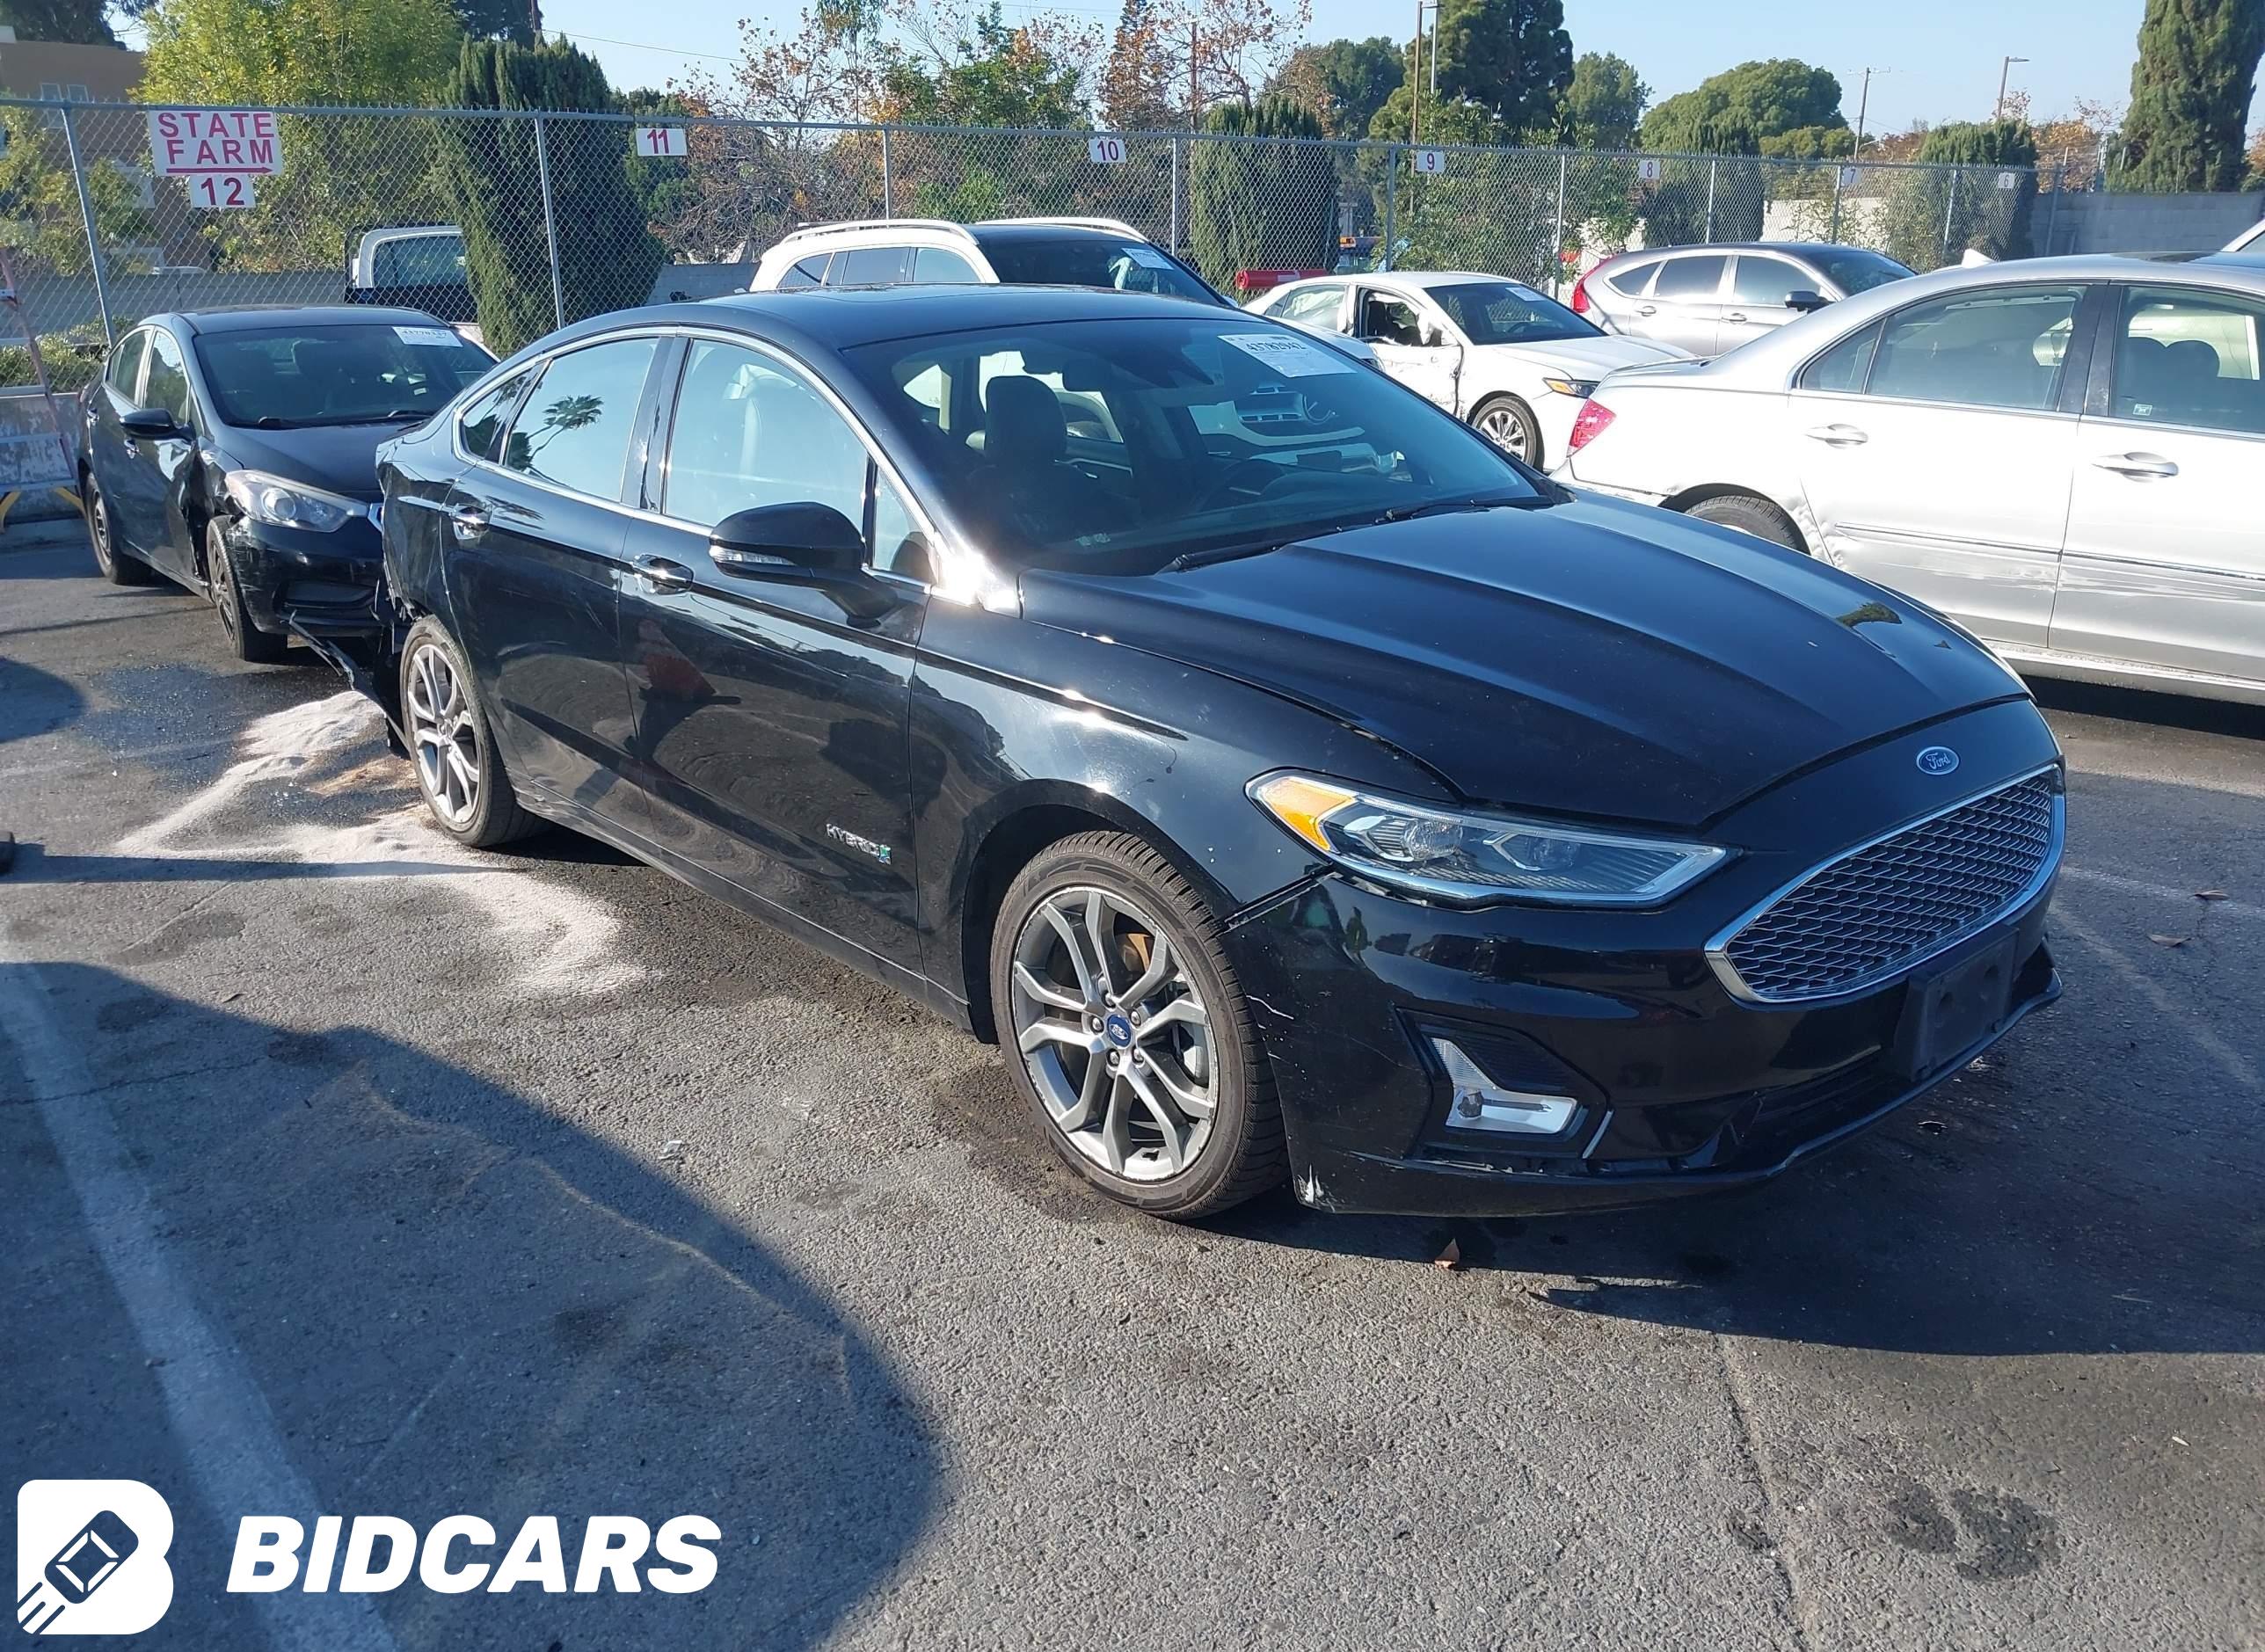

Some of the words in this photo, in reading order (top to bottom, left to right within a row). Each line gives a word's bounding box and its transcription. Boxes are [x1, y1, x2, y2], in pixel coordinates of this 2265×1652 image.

[157, 113, 274, 138] STATE
[166, 139, 273, 164] FARM
[646, 129, 670, 155] 11
[1096, 140, 1119, 161] 10
[1426, 152, 1435, 171] 9
[1646, 161, 1654, 178] 8
[1850, 168, 1856, 184] 7
[200, 177, 245, 206] 12
[1925, 752, 1951, 770] Ford
